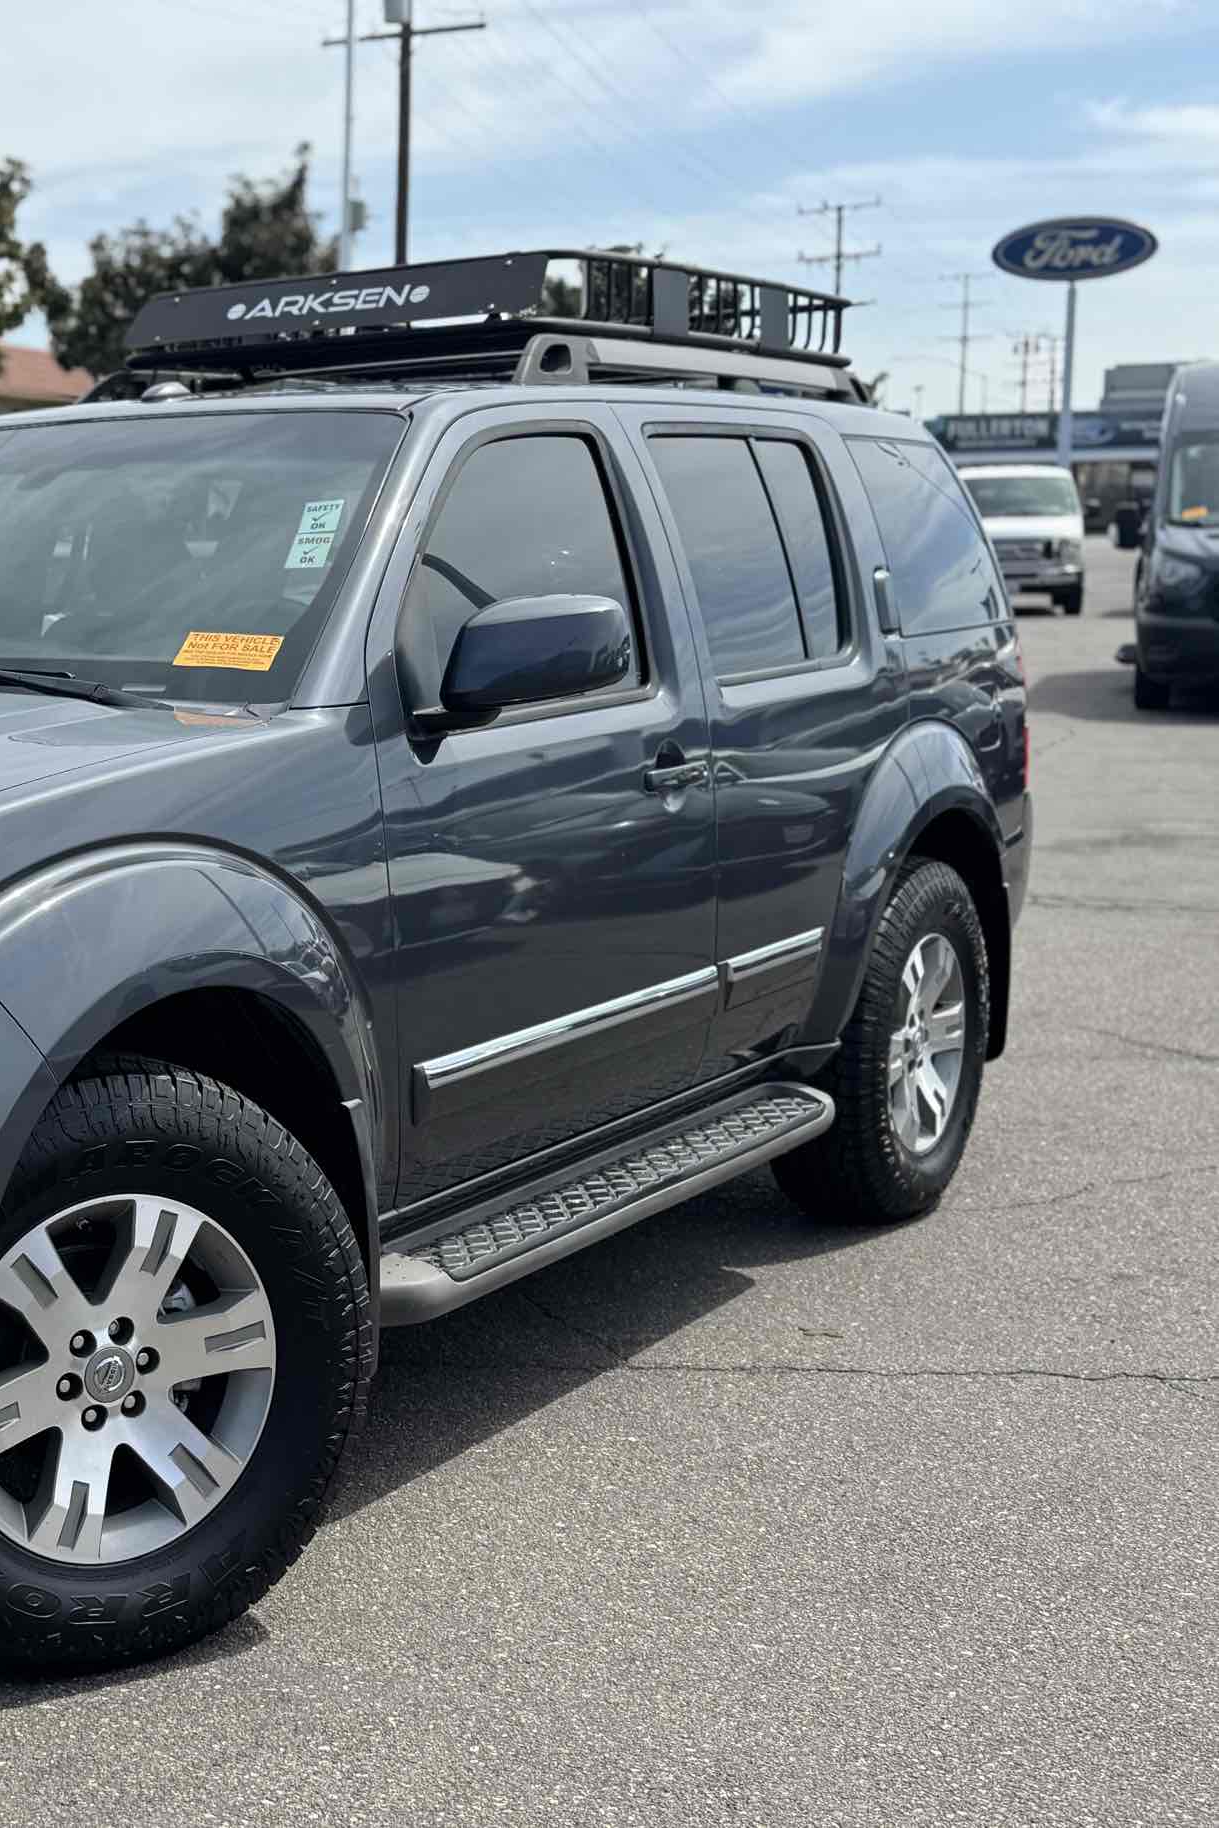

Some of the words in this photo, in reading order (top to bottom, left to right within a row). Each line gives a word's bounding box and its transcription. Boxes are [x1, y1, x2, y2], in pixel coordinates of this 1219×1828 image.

[1023, 228, 1123, 270] Ford
[244, 284, 411, 320] ARKSEN
[306, 503, 340, 513] SAFETY
[311, 522, 326, 530] OK
[297, 536, 332, 545] SMOG
[300, 555, 316, 564] OK
[191, 633, 221, 642] THIS
[224, 635, 281, 645] VEHICLE
[212, 642, 239, 651] FOR
[241, 644, 278, 654] SALE
